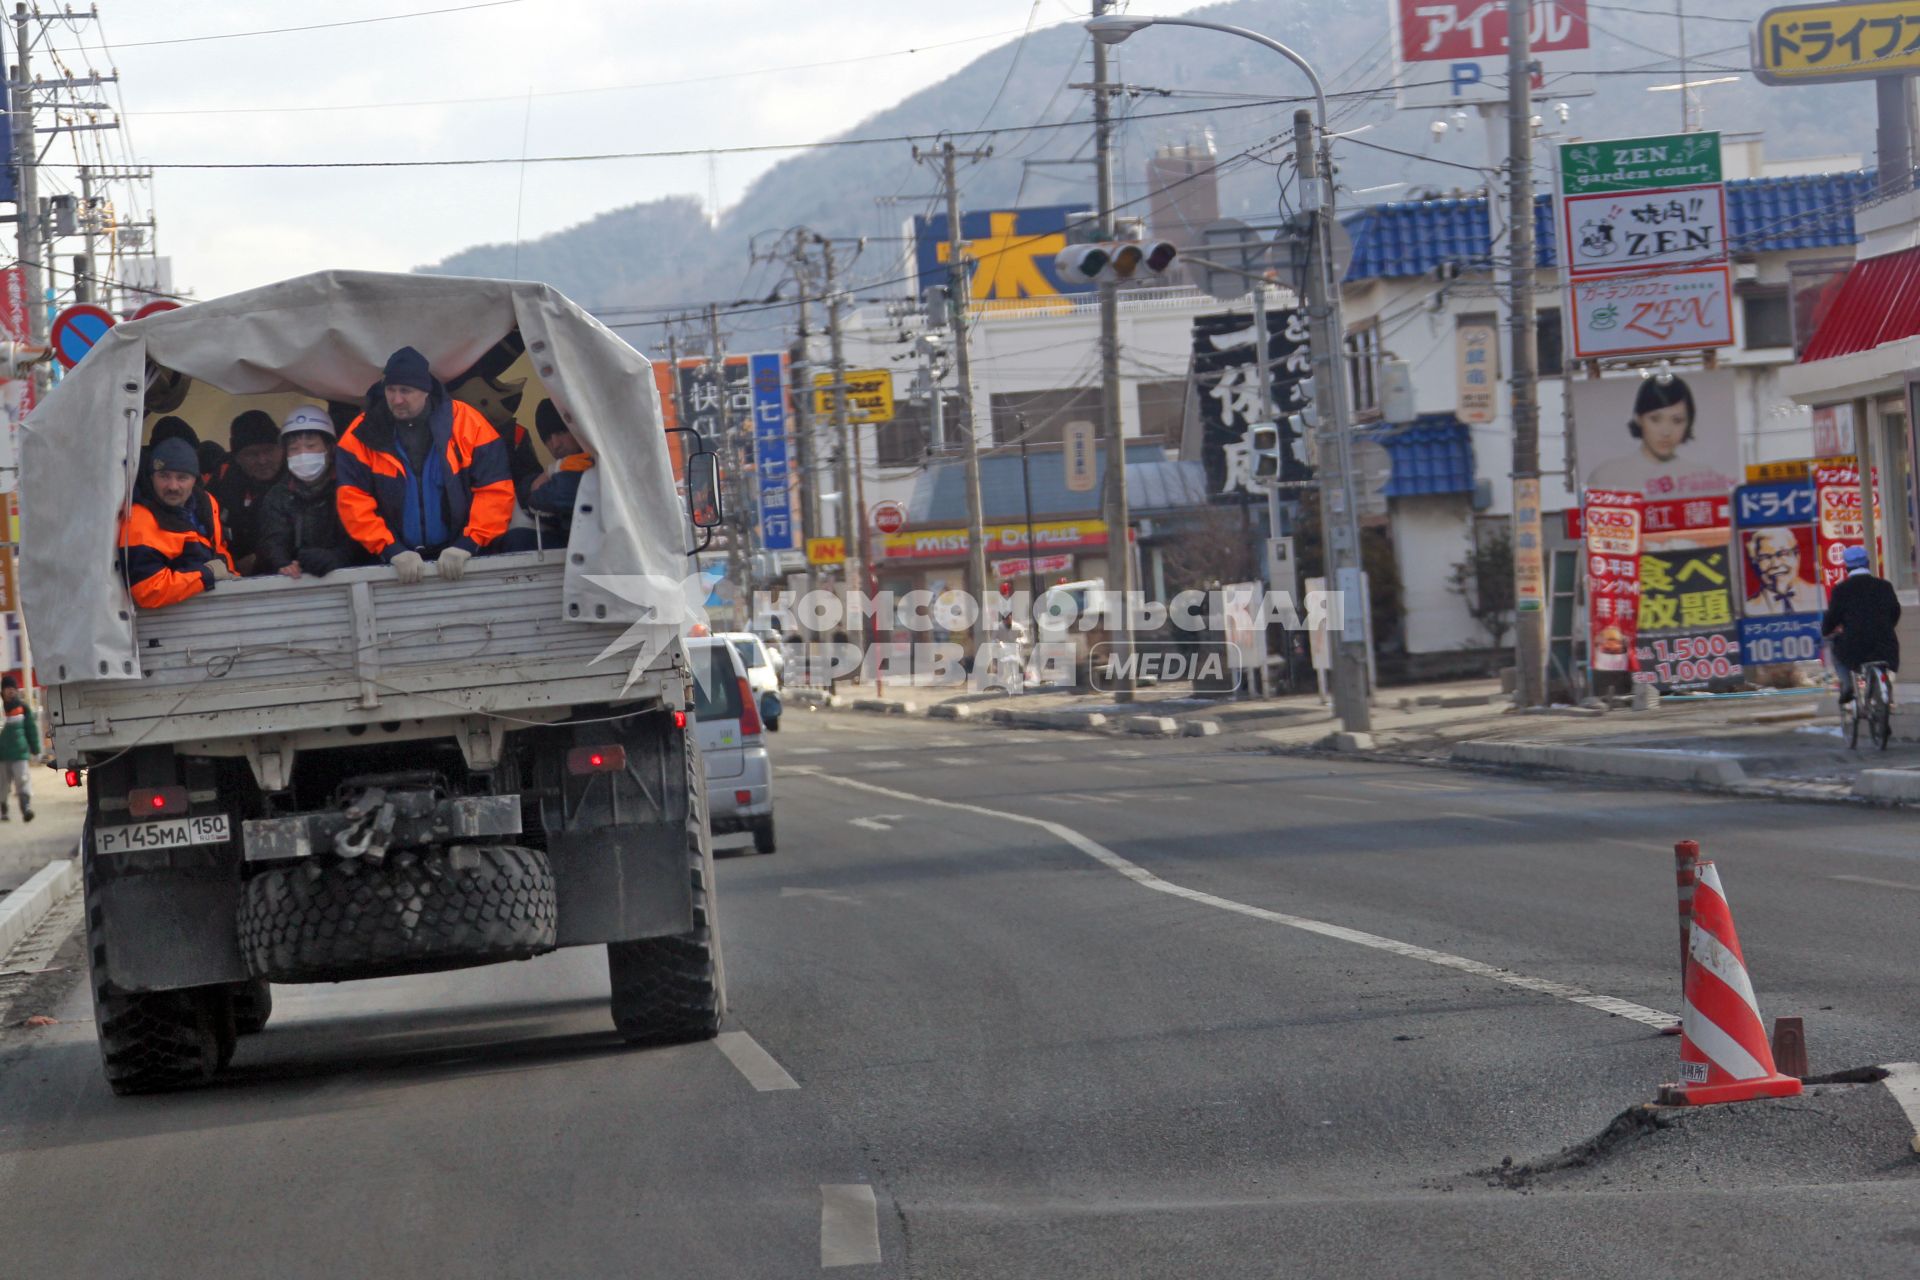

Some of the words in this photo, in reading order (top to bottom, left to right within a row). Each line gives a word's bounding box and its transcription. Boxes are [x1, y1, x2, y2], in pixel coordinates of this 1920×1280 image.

[1415, 0, 1572, 52] アイル
[1451, 62, 1481, 96] P
[1613, 146, 1669, 165] ZEN
[1577, 166, 1650, 186] garden
[1654, 163, 1708, 177] court
[1624, 225, 1714, 256] ZEN
[1623, 290, 1720, 340] ZEN
[756, 399, 787, 537] 七十七銀行
[813, 543, 836, 560] IN
[916, 531, 993, 552] mistr
[1640, 553, 1727, 593] 食べ
[1637, 588, 1733, 631] 放題
[1746, 634, 1815, 662] 10:00
[103, 825, 188, 850] Р145МА
[192, 816, 224, 834] 150
